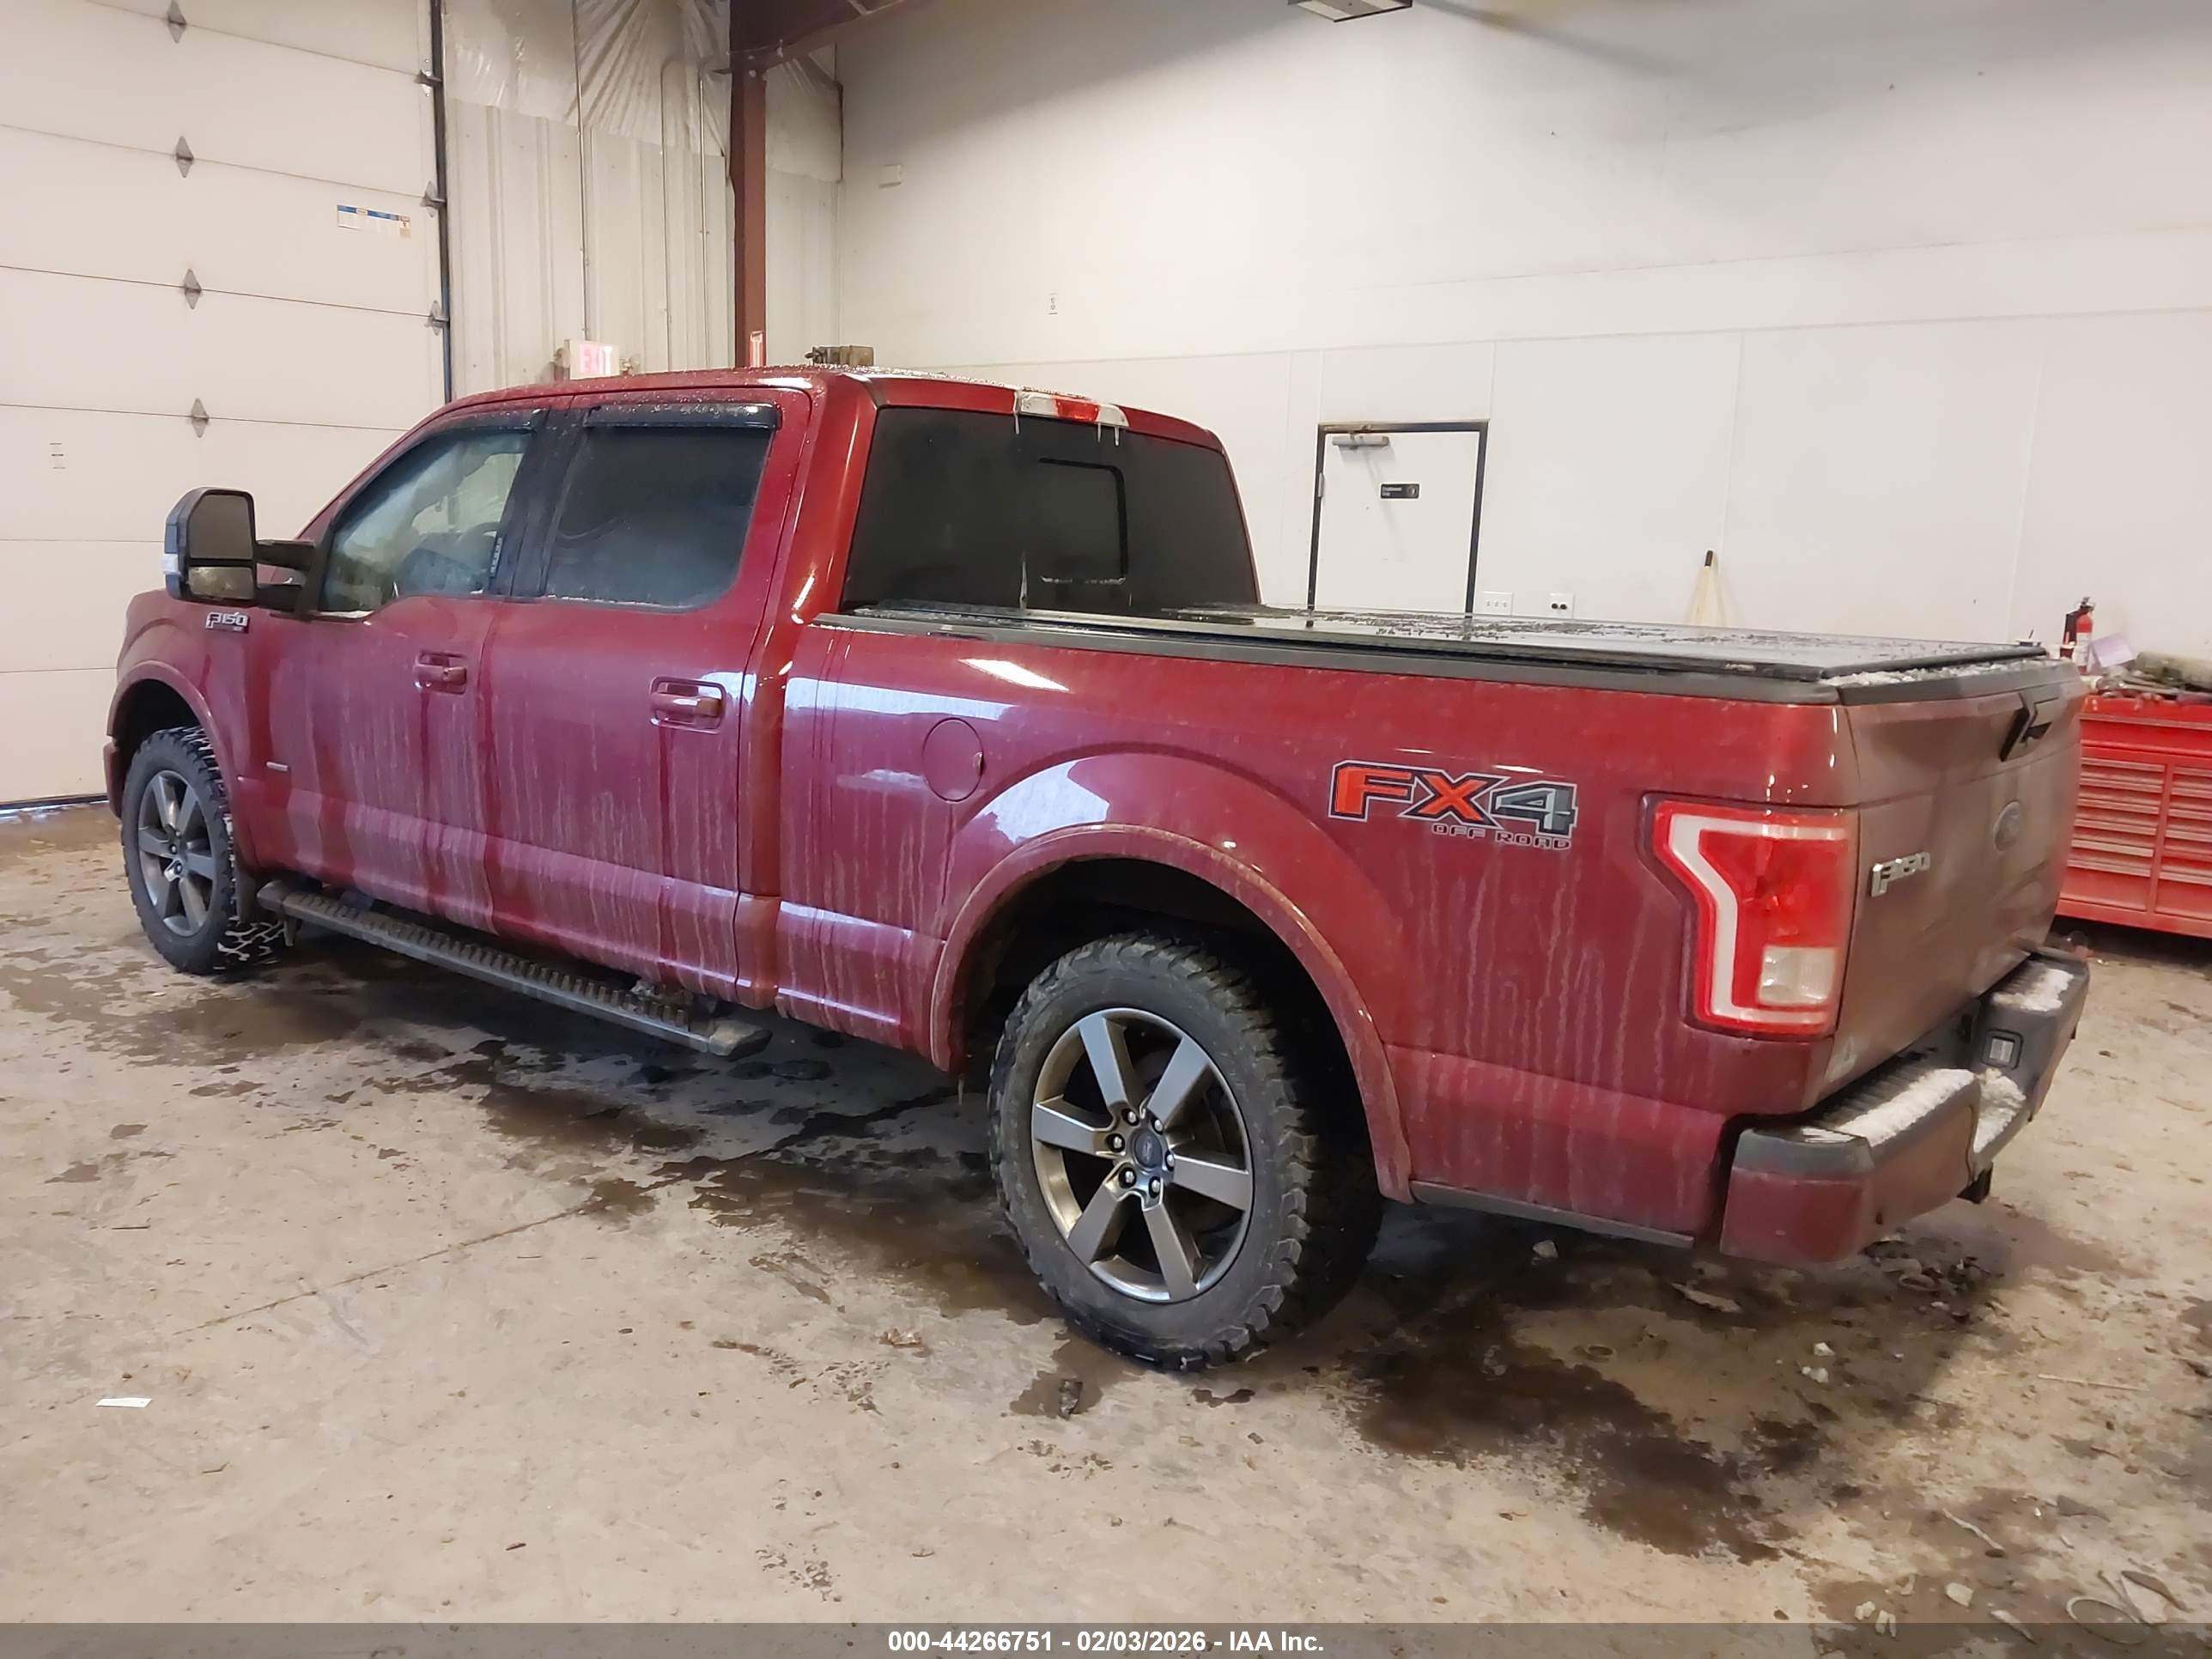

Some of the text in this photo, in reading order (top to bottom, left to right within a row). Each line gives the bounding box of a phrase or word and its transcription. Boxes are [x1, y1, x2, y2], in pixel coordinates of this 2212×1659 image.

[1328, 760, 1578, 838] FX4
[1431, 823, 1571, 850] OFF ROAD
